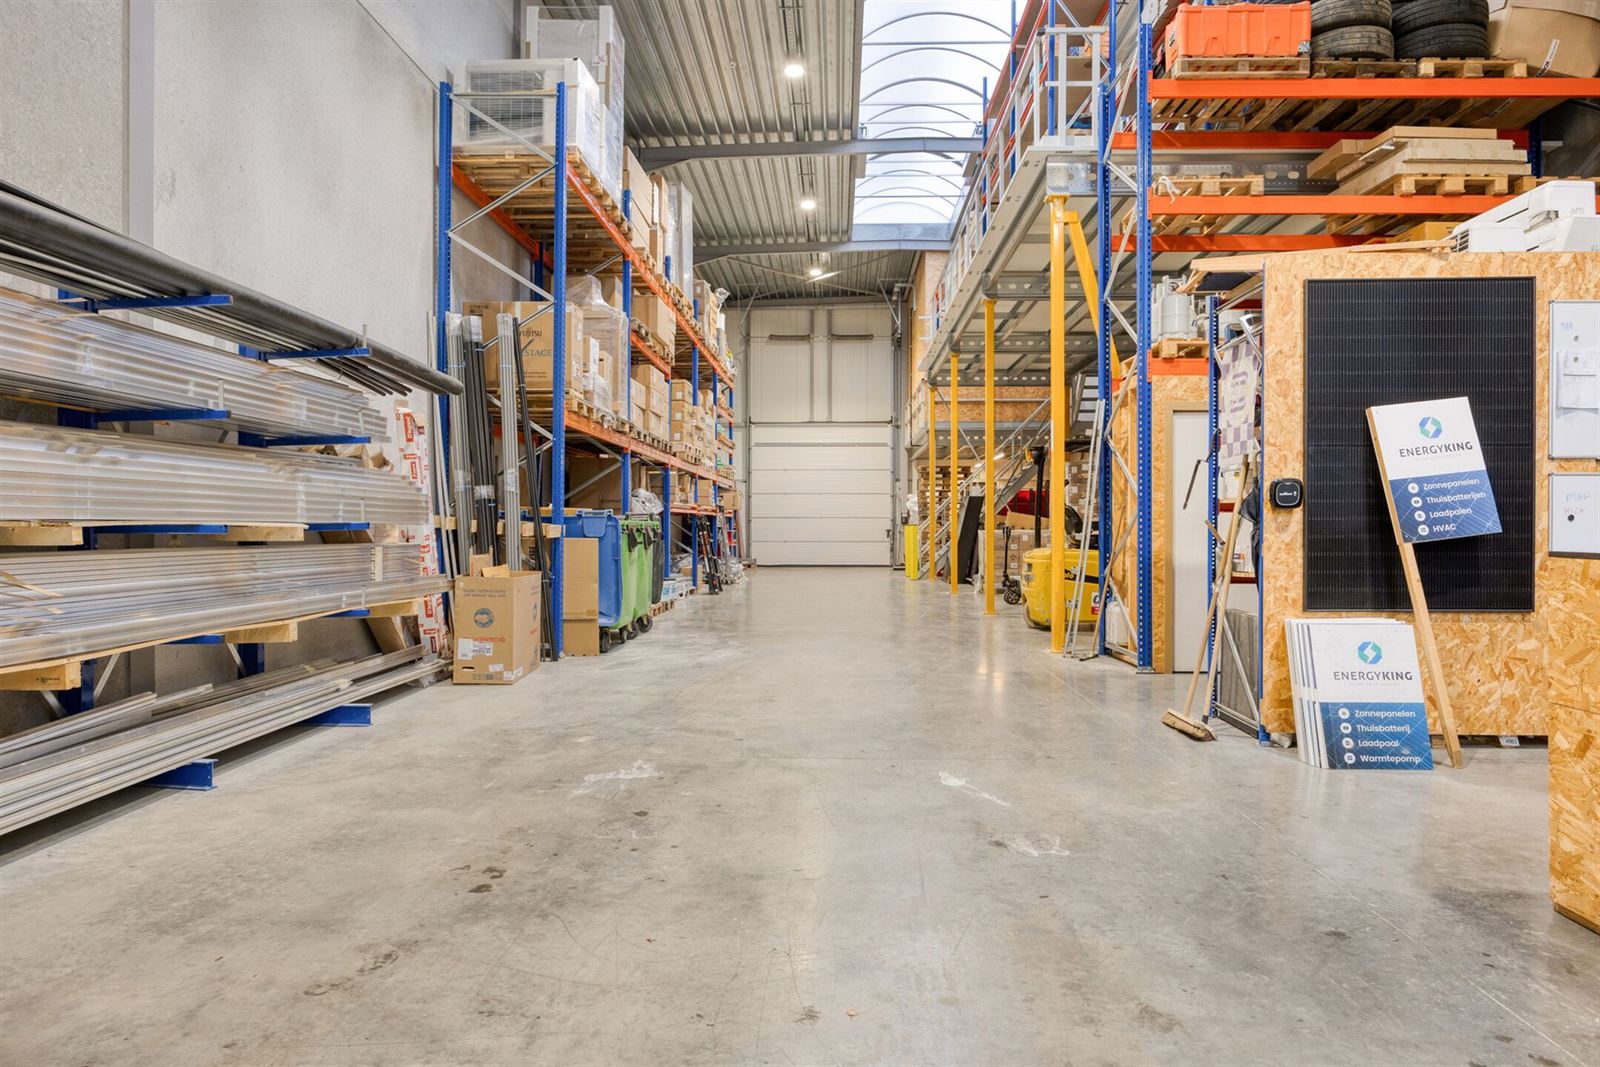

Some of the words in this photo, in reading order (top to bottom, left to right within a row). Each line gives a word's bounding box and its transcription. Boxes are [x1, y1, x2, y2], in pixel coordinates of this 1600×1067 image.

[1399, 441, 1473, 458] ENERGYKING
[1423, 478, 1480, 491] Zonnepanelen
[1426, 491, 1487, 504] Thuisbatterijen
[1429, 507, 1472, 519] Laadpalen
[1432, 523, 1457, 533] HVAC
[1333, 671, 1413, 681] ENERGYKING
[1354, 709, 1416, 719] Zonnepanelen
[1356, 724, 1411, 734] Thuisbatterij
[1358, 739, 1399, 749] Laadpaal
[1359, 754, 1421, 764] Warmtepomp
